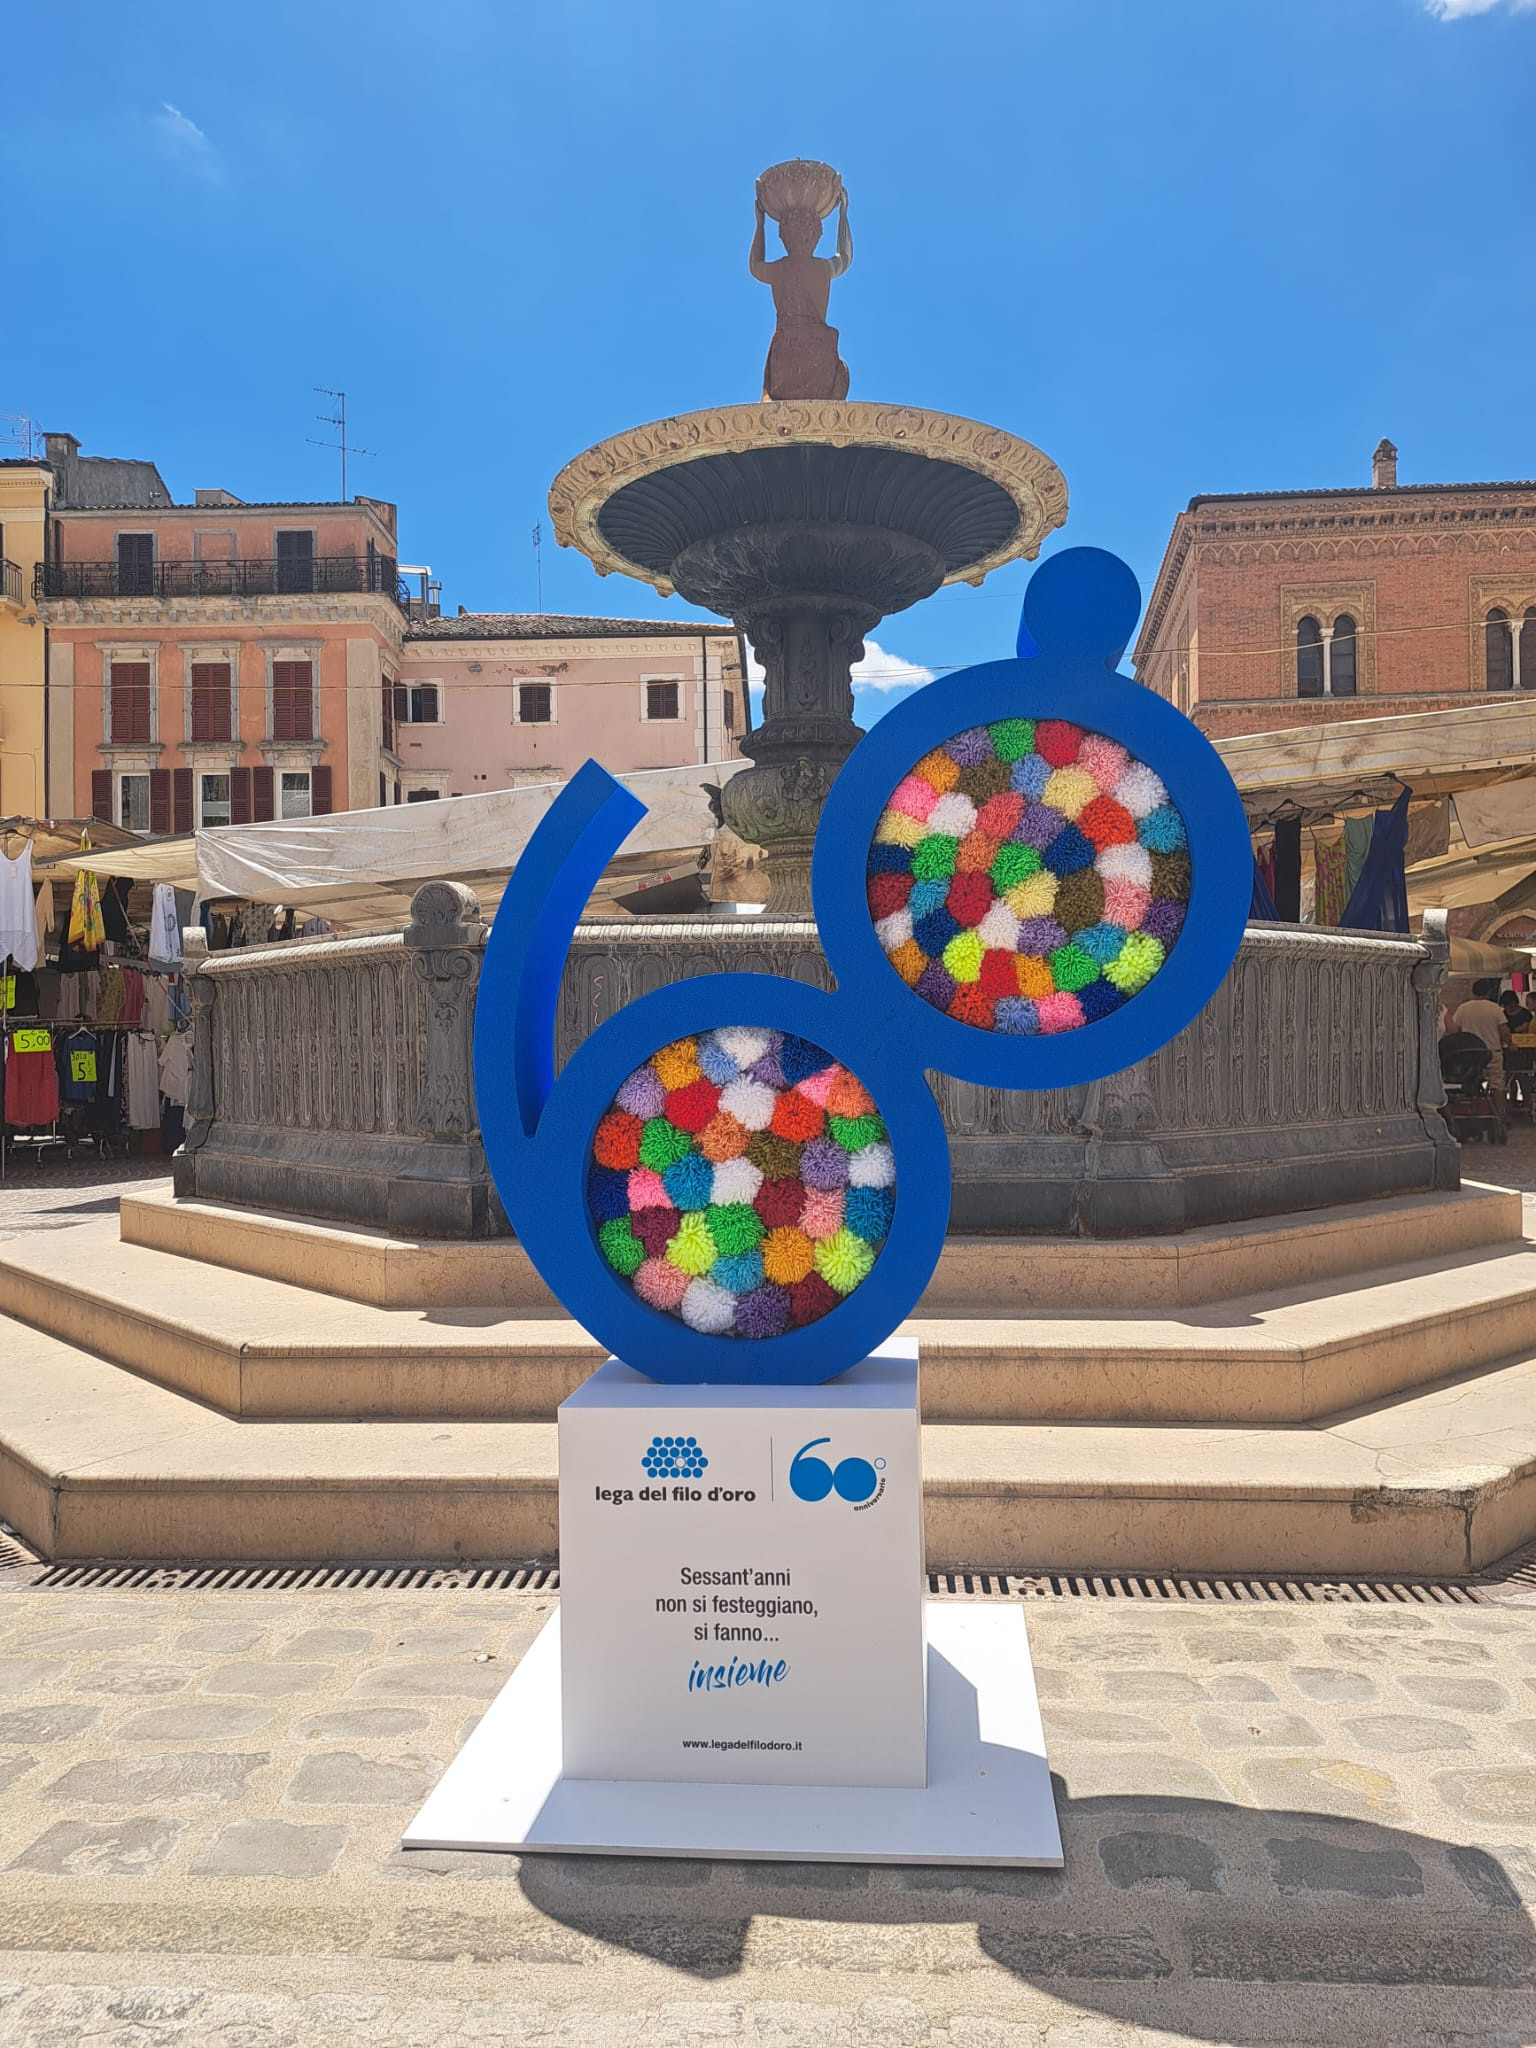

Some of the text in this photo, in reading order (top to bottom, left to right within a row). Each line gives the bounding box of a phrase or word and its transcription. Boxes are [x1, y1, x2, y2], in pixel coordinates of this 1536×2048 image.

[20, 1034, 50, 1049] 5,00
[78, 1062, 86, 1081] 5
[595, 1486, 757, 1505] lega del filo d'oro
[680, 1566, 791, 1587] Sessant'anni
[655, 1595, 818, 1618] non si festeggiano,
[694, 1622, 779, 1642] si fanno...
[688, 1655, 792, 1693] insieme
[682, 1738, 803, 1752] www.legadelfilodoro.it
